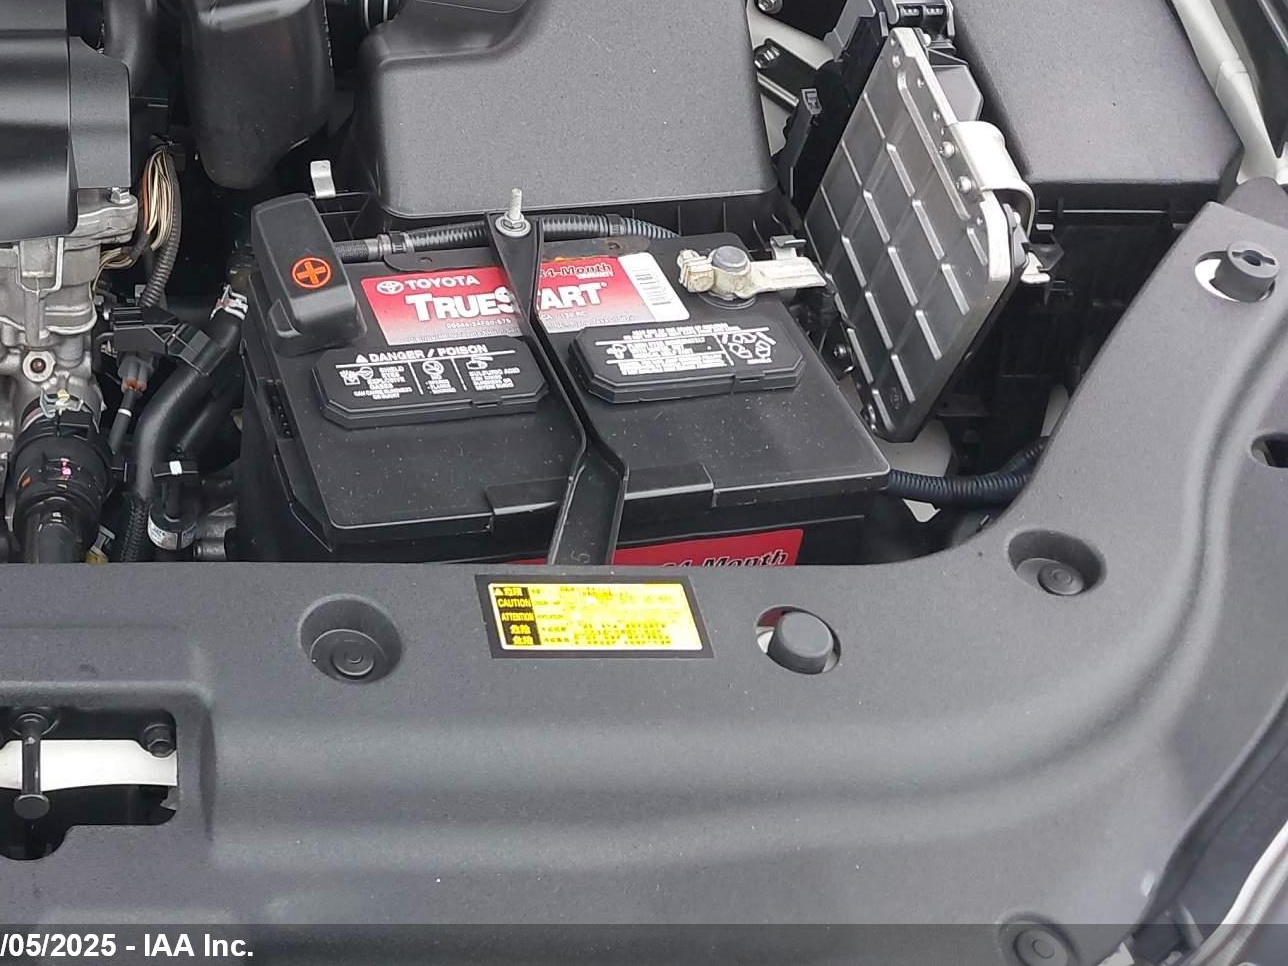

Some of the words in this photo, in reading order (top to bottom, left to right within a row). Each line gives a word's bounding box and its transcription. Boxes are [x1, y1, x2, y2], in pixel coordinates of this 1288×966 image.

[403, 274, 481, 291] TOYOTA
[369, 349, 425, 363] DANGER
[437, 344, 489, 356] POISON
[497, 598, 532, 608] CAUTION
[500, 612, 535, 622] ATTENTION
